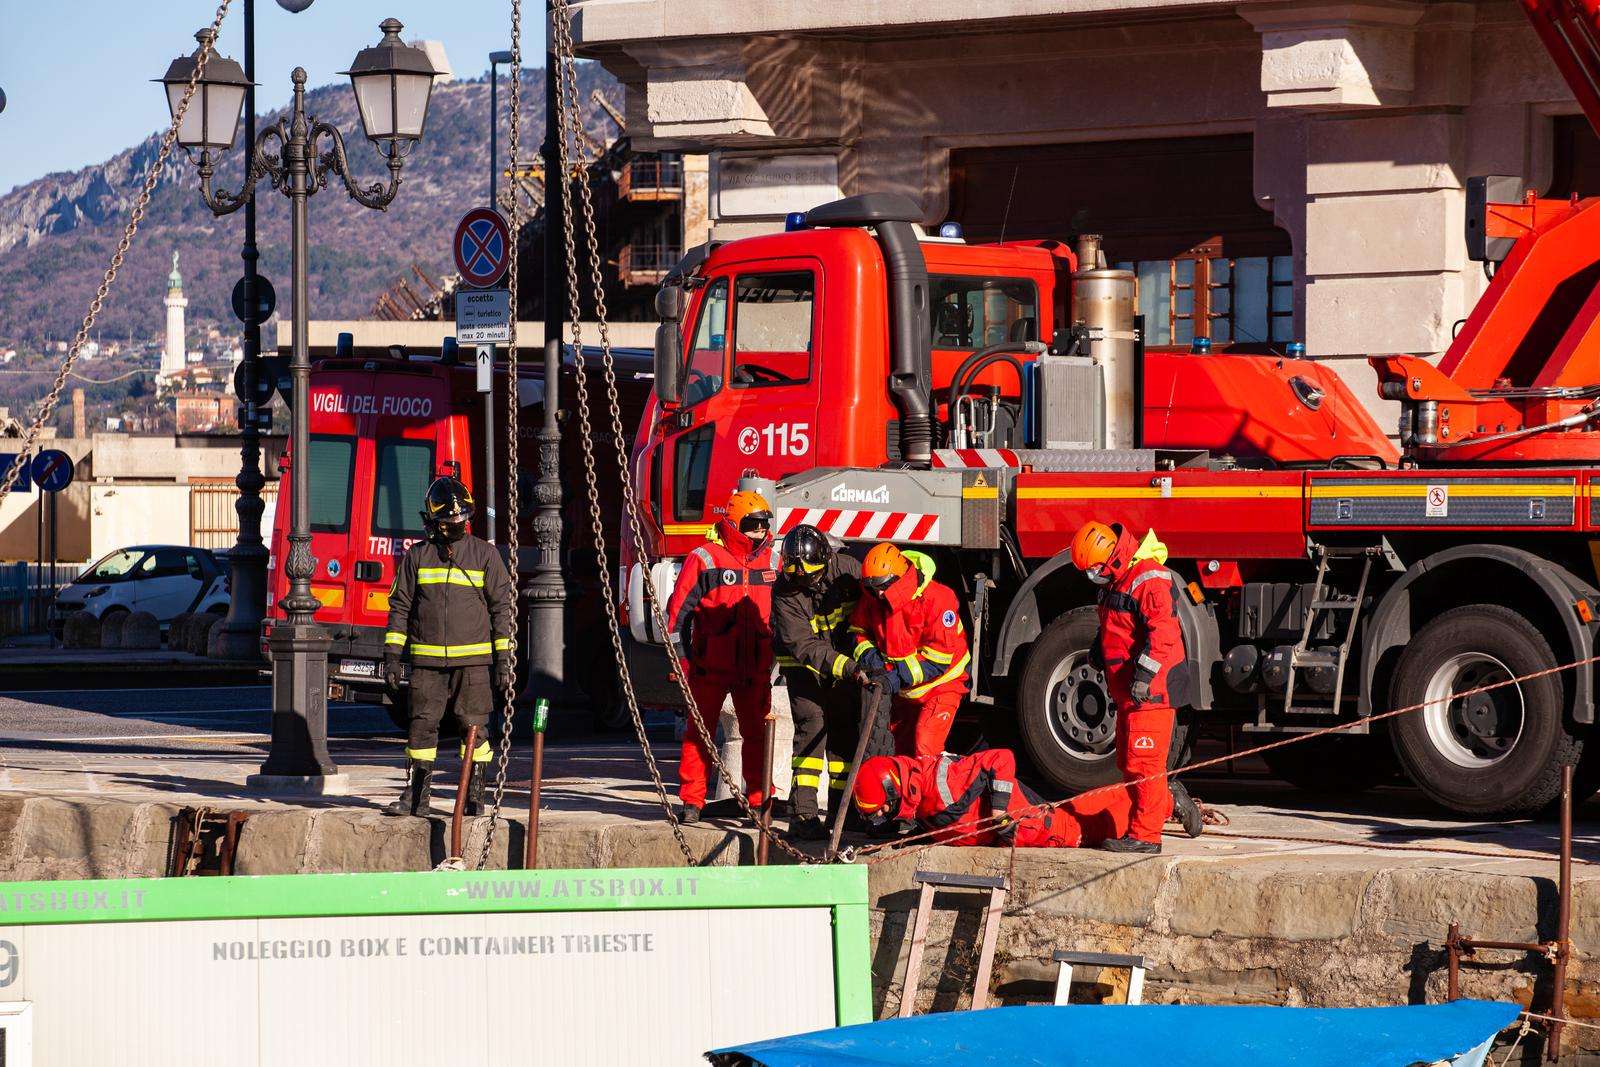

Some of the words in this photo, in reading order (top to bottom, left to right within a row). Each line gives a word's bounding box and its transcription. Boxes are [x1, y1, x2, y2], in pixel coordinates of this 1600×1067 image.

[467, 293, 494, 303] eccetto
[477, 309, 502, 318] turistico
[476, 331, 485, 339] 20
[487, 330, 506, 339] minuti
[313, 392, 350, 413] VIGILI
[352, 395, 378, 414] DEL
[381, 396, 432, 417] FUOCO
[761, 422, 810, 457] 115
[368, 536, 424, 556] TRIES
[465, 877, 701, 900] WWW.ATSBOX.IT
[212, 938, 332, 961] NOLEGGIO
[340, 937, 389, 958] BOX
[396, 937, 407, 956] E
[419, 935, 554, 957] CONTAINER
[560, 933, 654, 954] TRIESTE
